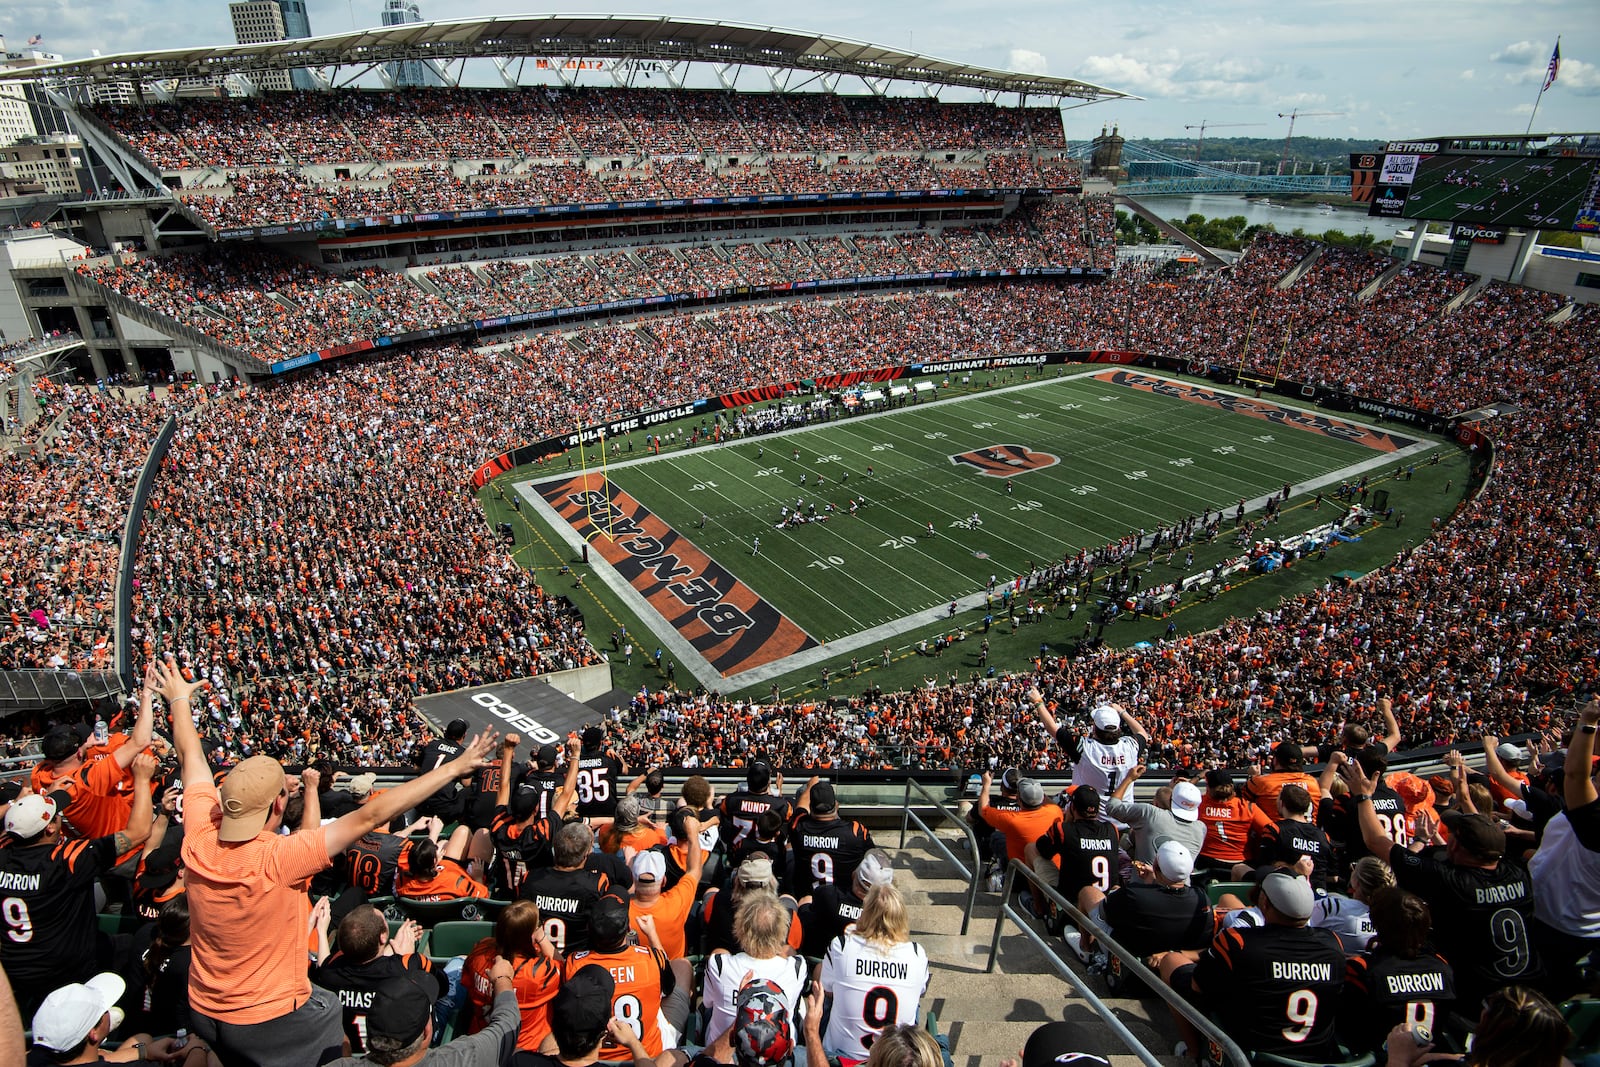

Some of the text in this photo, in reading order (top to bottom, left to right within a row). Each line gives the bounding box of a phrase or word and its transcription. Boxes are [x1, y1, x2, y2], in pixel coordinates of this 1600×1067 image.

[1387, 142, 1439, 152] BETFRED
[1456, 225, 1501, 239] Paycor
[283, 356, 310, 369] BUD LIGHT
[922, 359, 990, 374] CINCINNATI
[1122, 375, 1371, 439] BENGALS
[1358, 401, 1386, 413] WHO
[569, 405, 694, 446] RULE THE JUNGLE
[757, 466, 784, 477] 20
[693, 480, 719, 491] 10
[1069, 484, 1098, 495] 50
[1016, 500, 1044, 511] 40
[884, 535, 917, 550] 20
[566, 489, 756, 636] BENGALS
[811, 555, 845, 571] 10
[471, 692, 560, 745] GEICO
[437, 742, 459, 755] CHASE
[578, 758, 602, 769] HIGGINS
[1101, 754, 1125, 766] CHASE
[576, 767, 610, 804] 85
[741, 801, 772, 814] MUNOZ
[1205, 807, 1232, 818] CHASE
[1372, 798, 1399, 811] HURST
[1214, 821, 1228, 842] 1
[803, 834, 840, 849] BURROW
[1080, 837, 1112, 850] BURROW
[1292, 837, 1320, 853] CHASE
[348, 849, 382, 895] 18
[810, 852, 835, 889] 9
[1091, 855, 1110, 892] 9
[1475, 880, 1525, 904] BURROW
[535, 894, 579, 914] BURROW
[2, 896, 34, 943] 9
[1490, 907, 1530, 977] 9
[856, 958, 909, 980] BURROW
[1272, 961, 1331, 982] BURROW
[1386, 972, 1444, 994] BURROW
[338, 989, 376, 1010] CHAS
[859, 985, 900, 1051] 9
[1281, 988, 1319, 1043] 9
